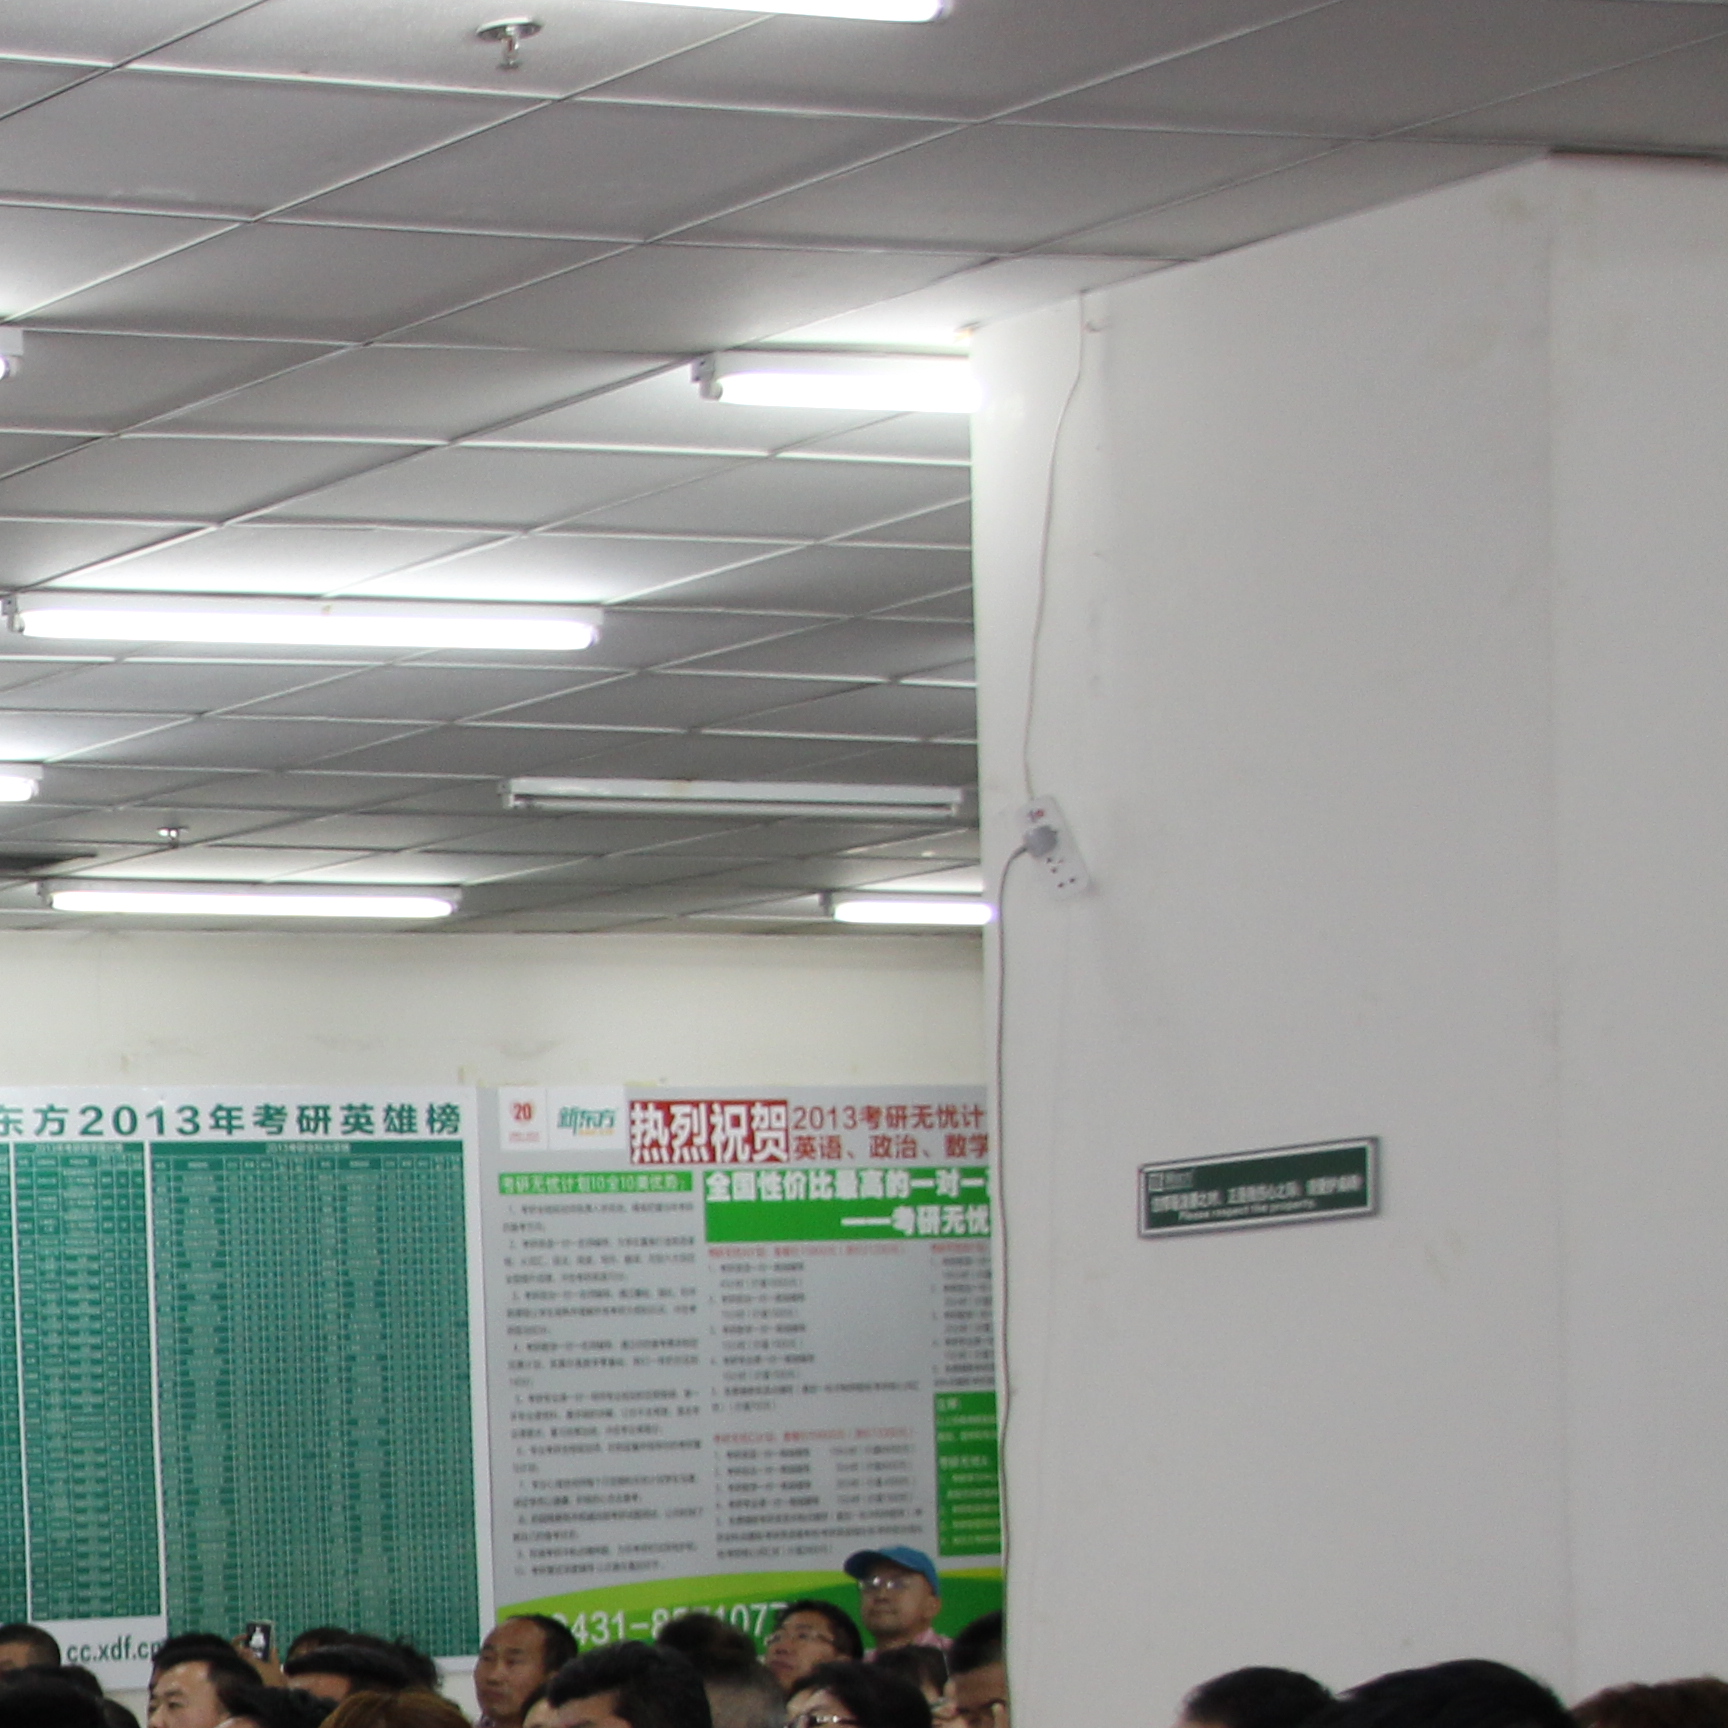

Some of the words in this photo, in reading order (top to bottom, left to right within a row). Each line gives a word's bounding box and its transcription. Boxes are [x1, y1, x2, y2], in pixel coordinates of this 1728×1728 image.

[630, 1102, 788, 1163] 热烈祝贺
[793, 1104, 985, 1130] 2013考研无忧计
[705, 1168, 990, 1201] 全国性价比最高的一对一
